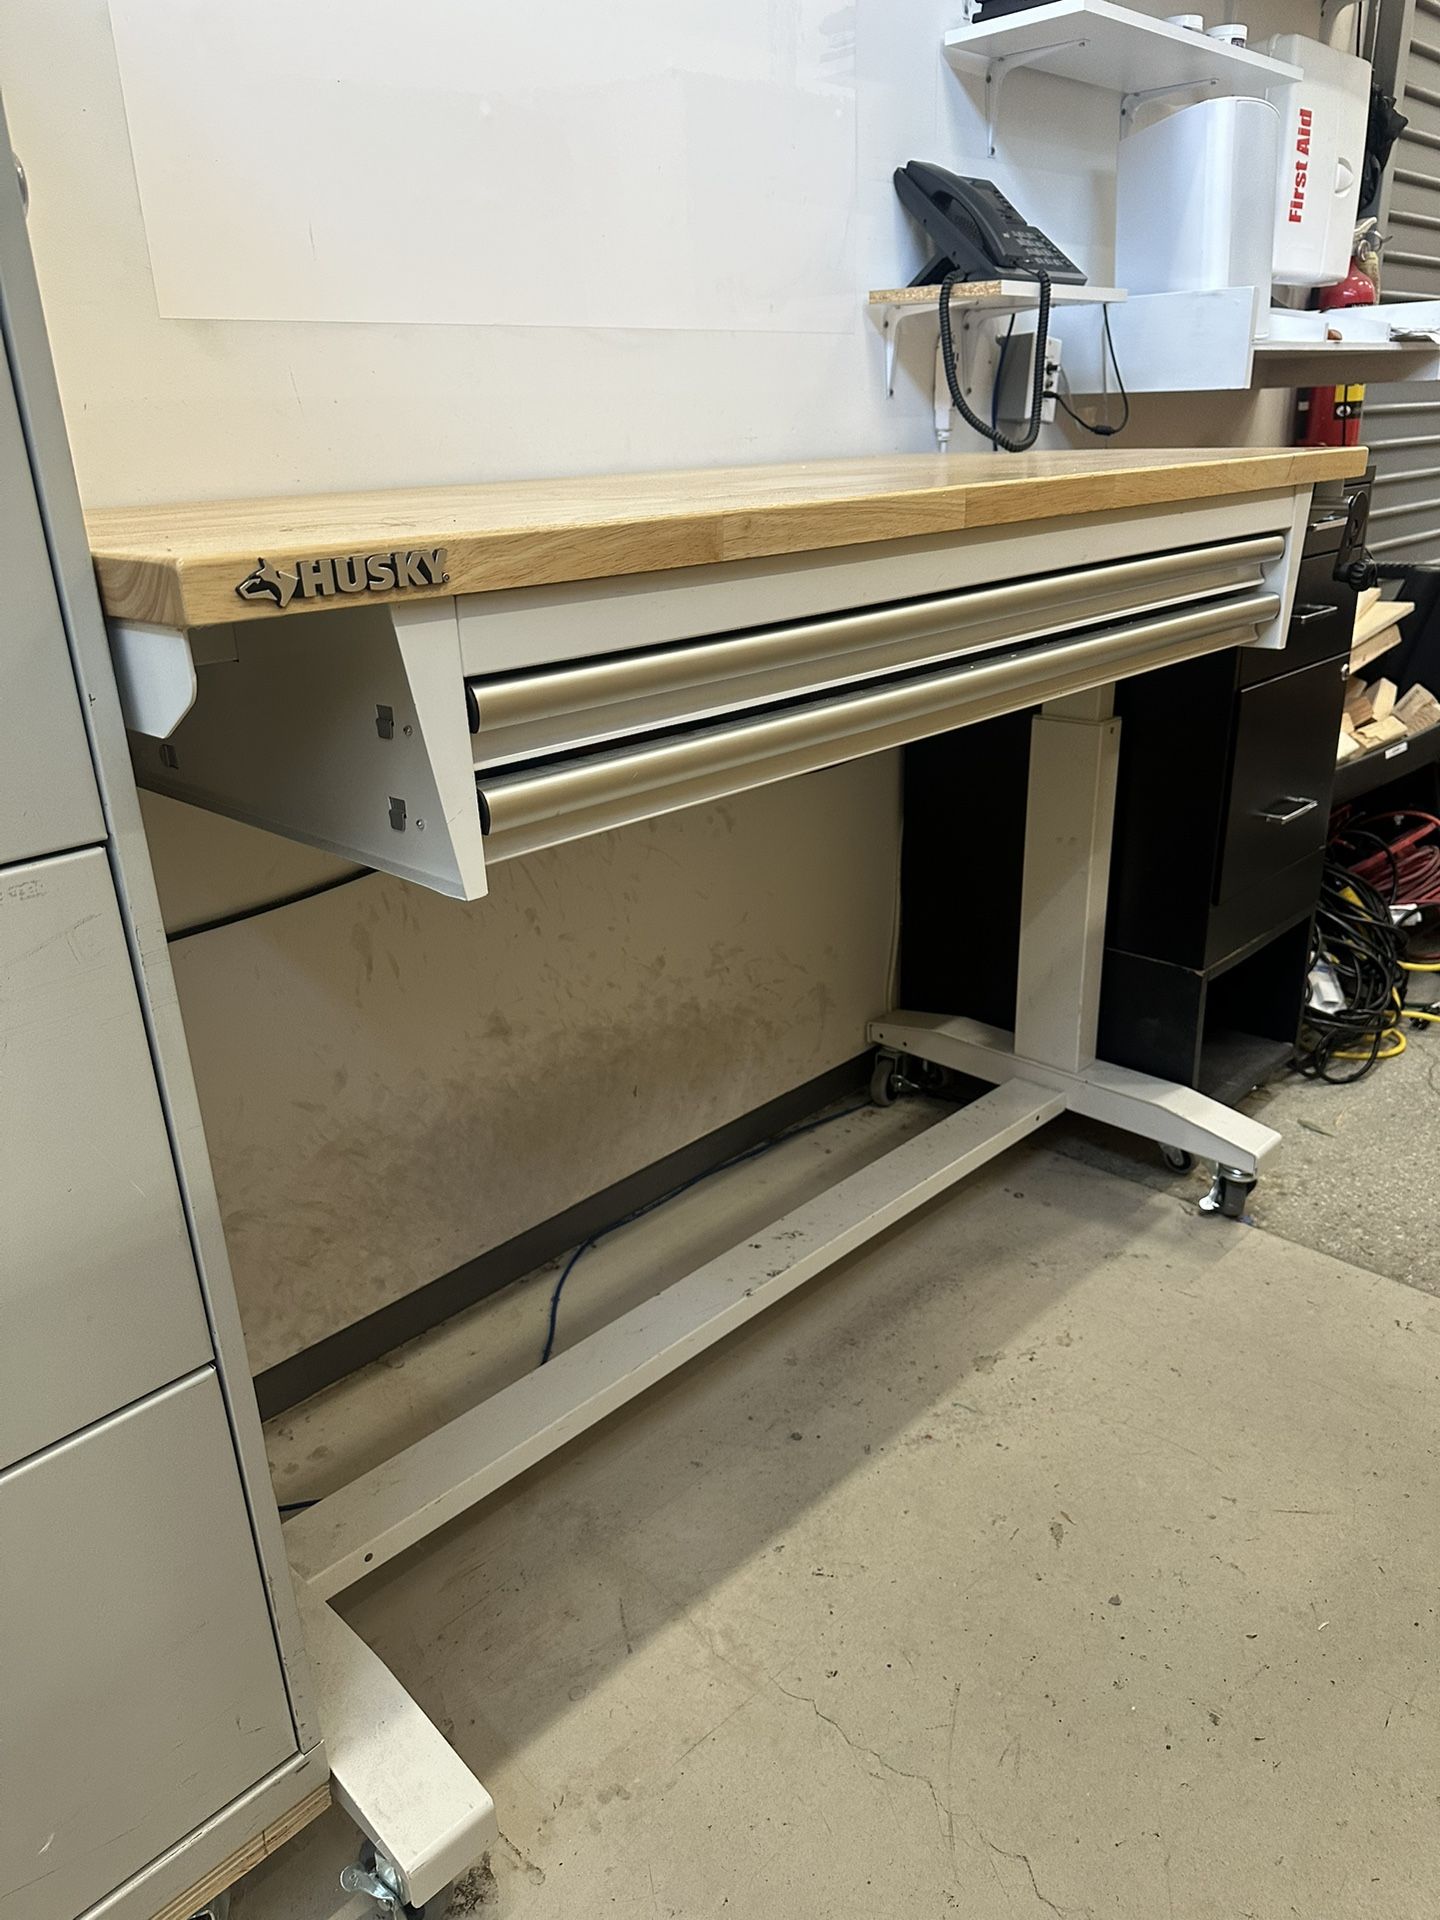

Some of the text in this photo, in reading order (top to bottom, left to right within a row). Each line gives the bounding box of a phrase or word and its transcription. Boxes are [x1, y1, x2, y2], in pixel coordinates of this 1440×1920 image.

[1288, 108, 1313, 223] First Aid
[298, 549, 449, 598] HUSKY
